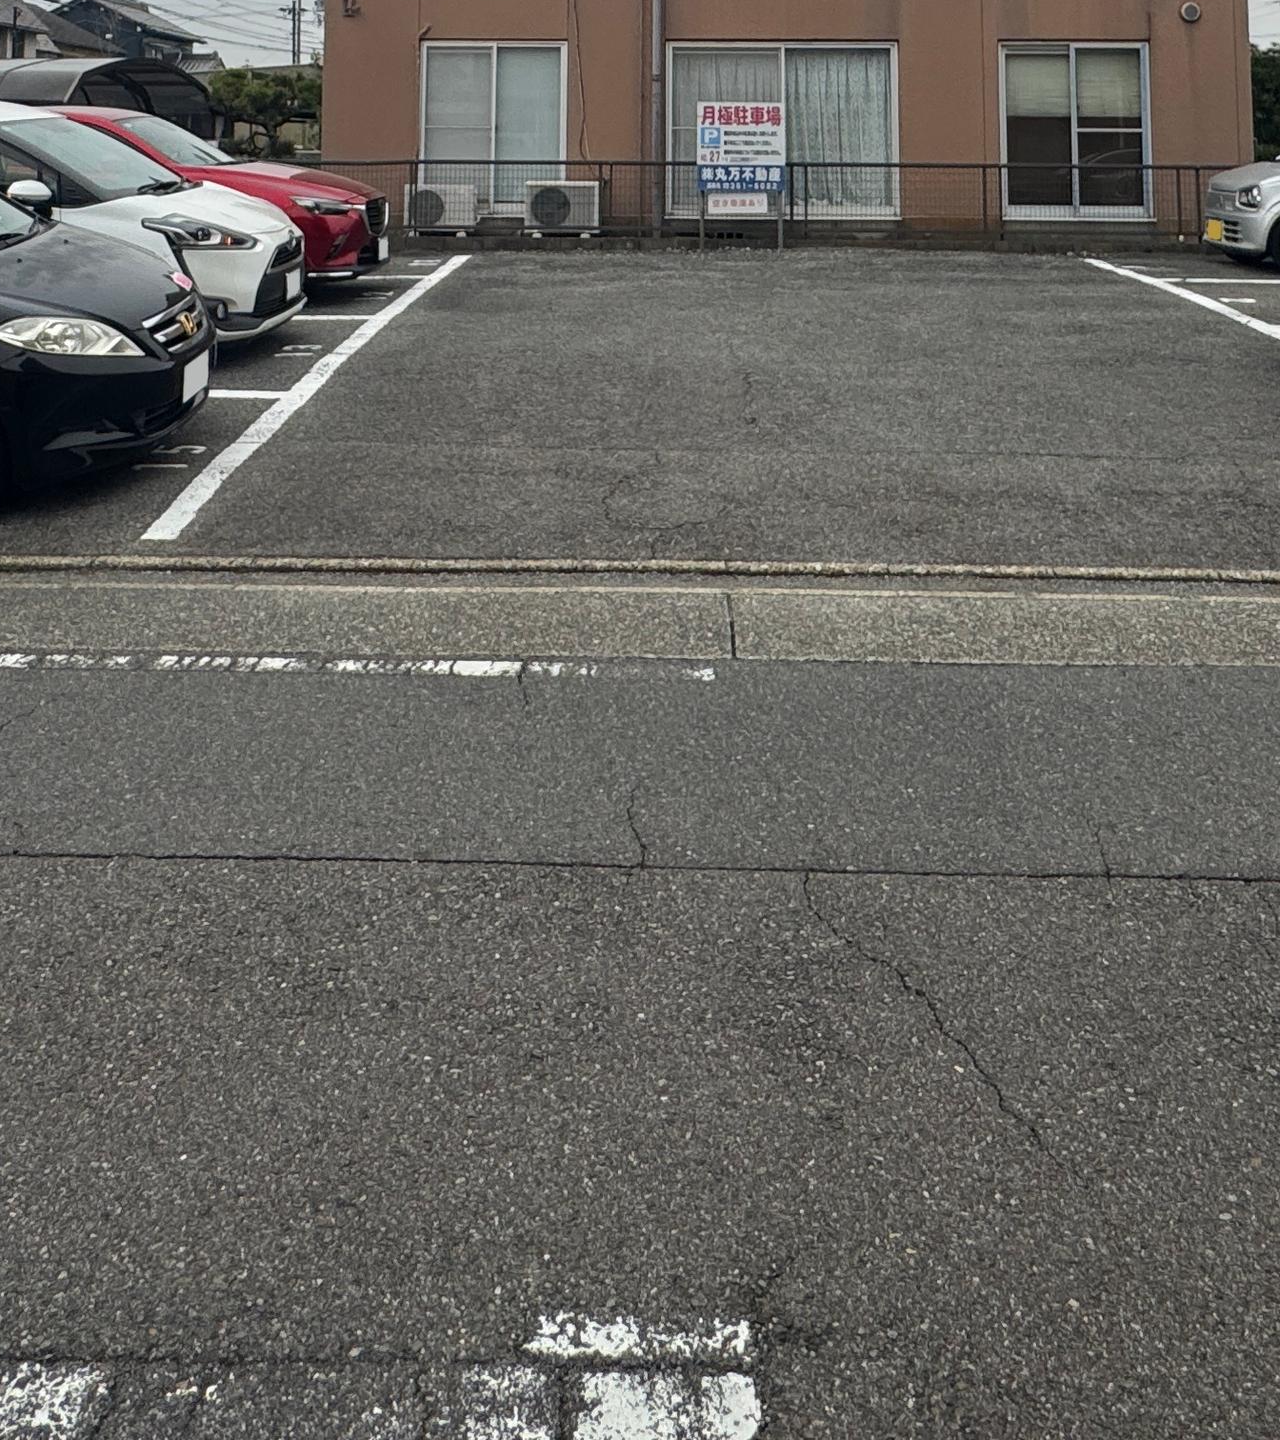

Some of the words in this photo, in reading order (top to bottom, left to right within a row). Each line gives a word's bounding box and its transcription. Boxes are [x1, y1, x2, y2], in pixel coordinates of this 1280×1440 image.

[701, 106, 781, 126] 月極駐車場
[709, 151, 720, 162] 27
